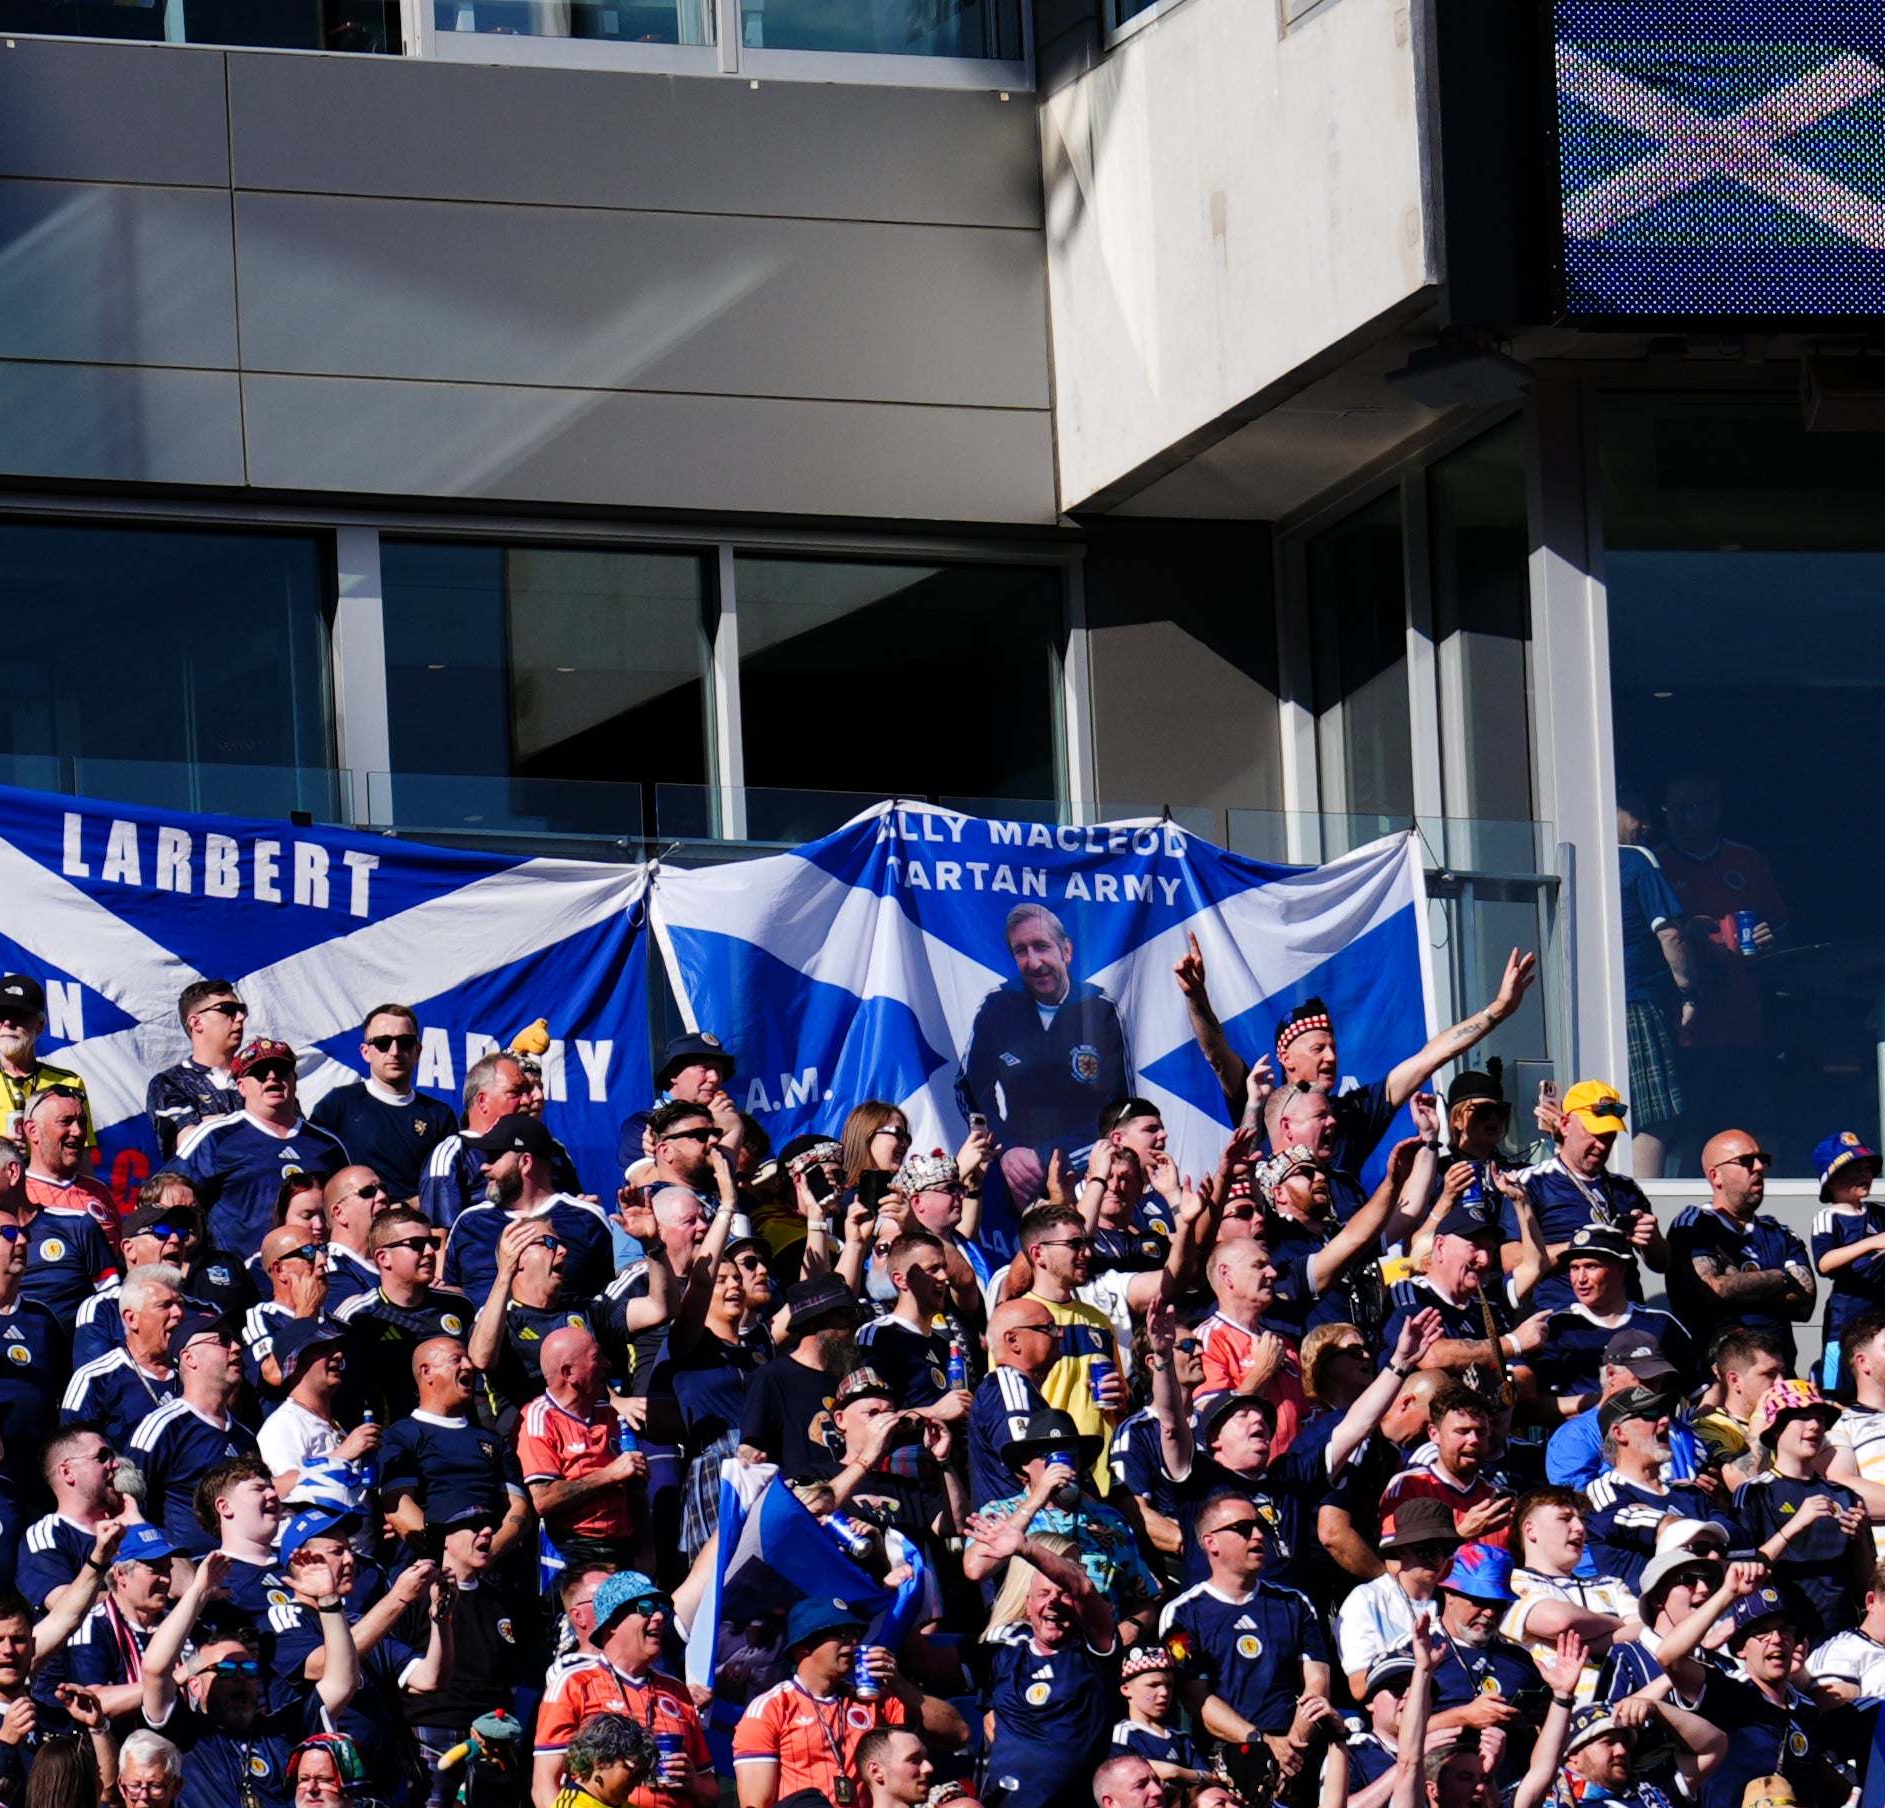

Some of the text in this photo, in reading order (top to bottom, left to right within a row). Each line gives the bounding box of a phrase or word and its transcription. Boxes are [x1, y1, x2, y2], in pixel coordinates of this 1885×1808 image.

[987, 819, 1188, 859] MACLEOD
[62, 812, 380, 918] LARBERT
[1064, 871, 1182, 906] ARMY
